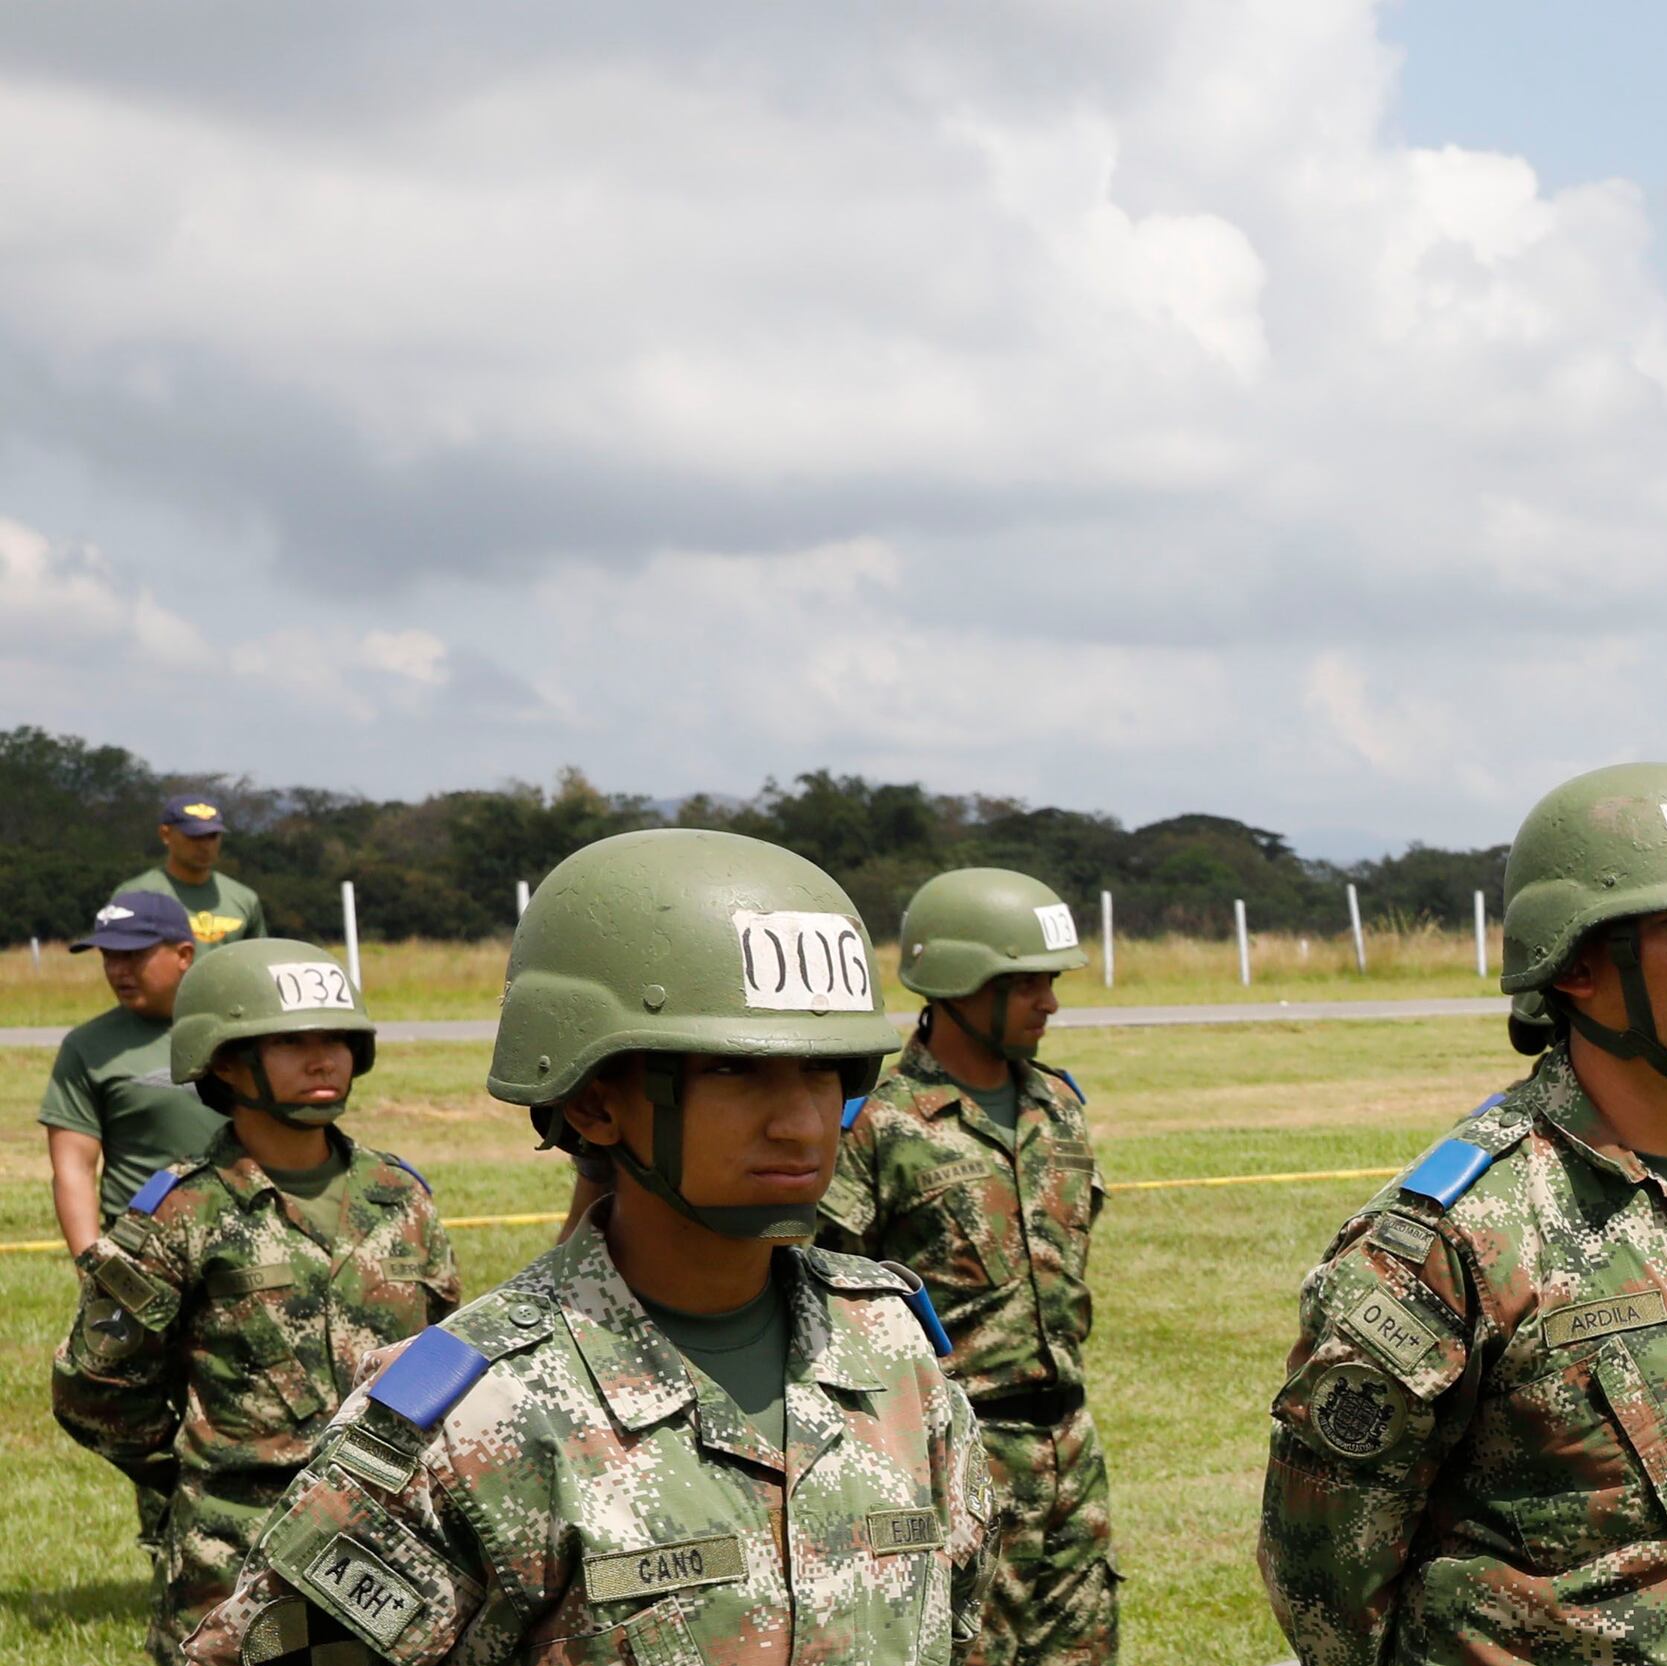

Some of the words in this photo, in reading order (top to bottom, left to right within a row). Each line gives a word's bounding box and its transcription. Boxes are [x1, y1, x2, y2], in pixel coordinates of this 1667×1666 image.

[742, 926, 868, 997] 006
[275, 968, 350, 1004] 032
[1363, 1305, 1381, 1325] O
[1377, 1315, 1421, 1349] RH+
[1570, 1306, 1641, 1333] ARDILA
[324, 1556, 351, 1585] A
[348, 1573, 405, 1619] RH+
